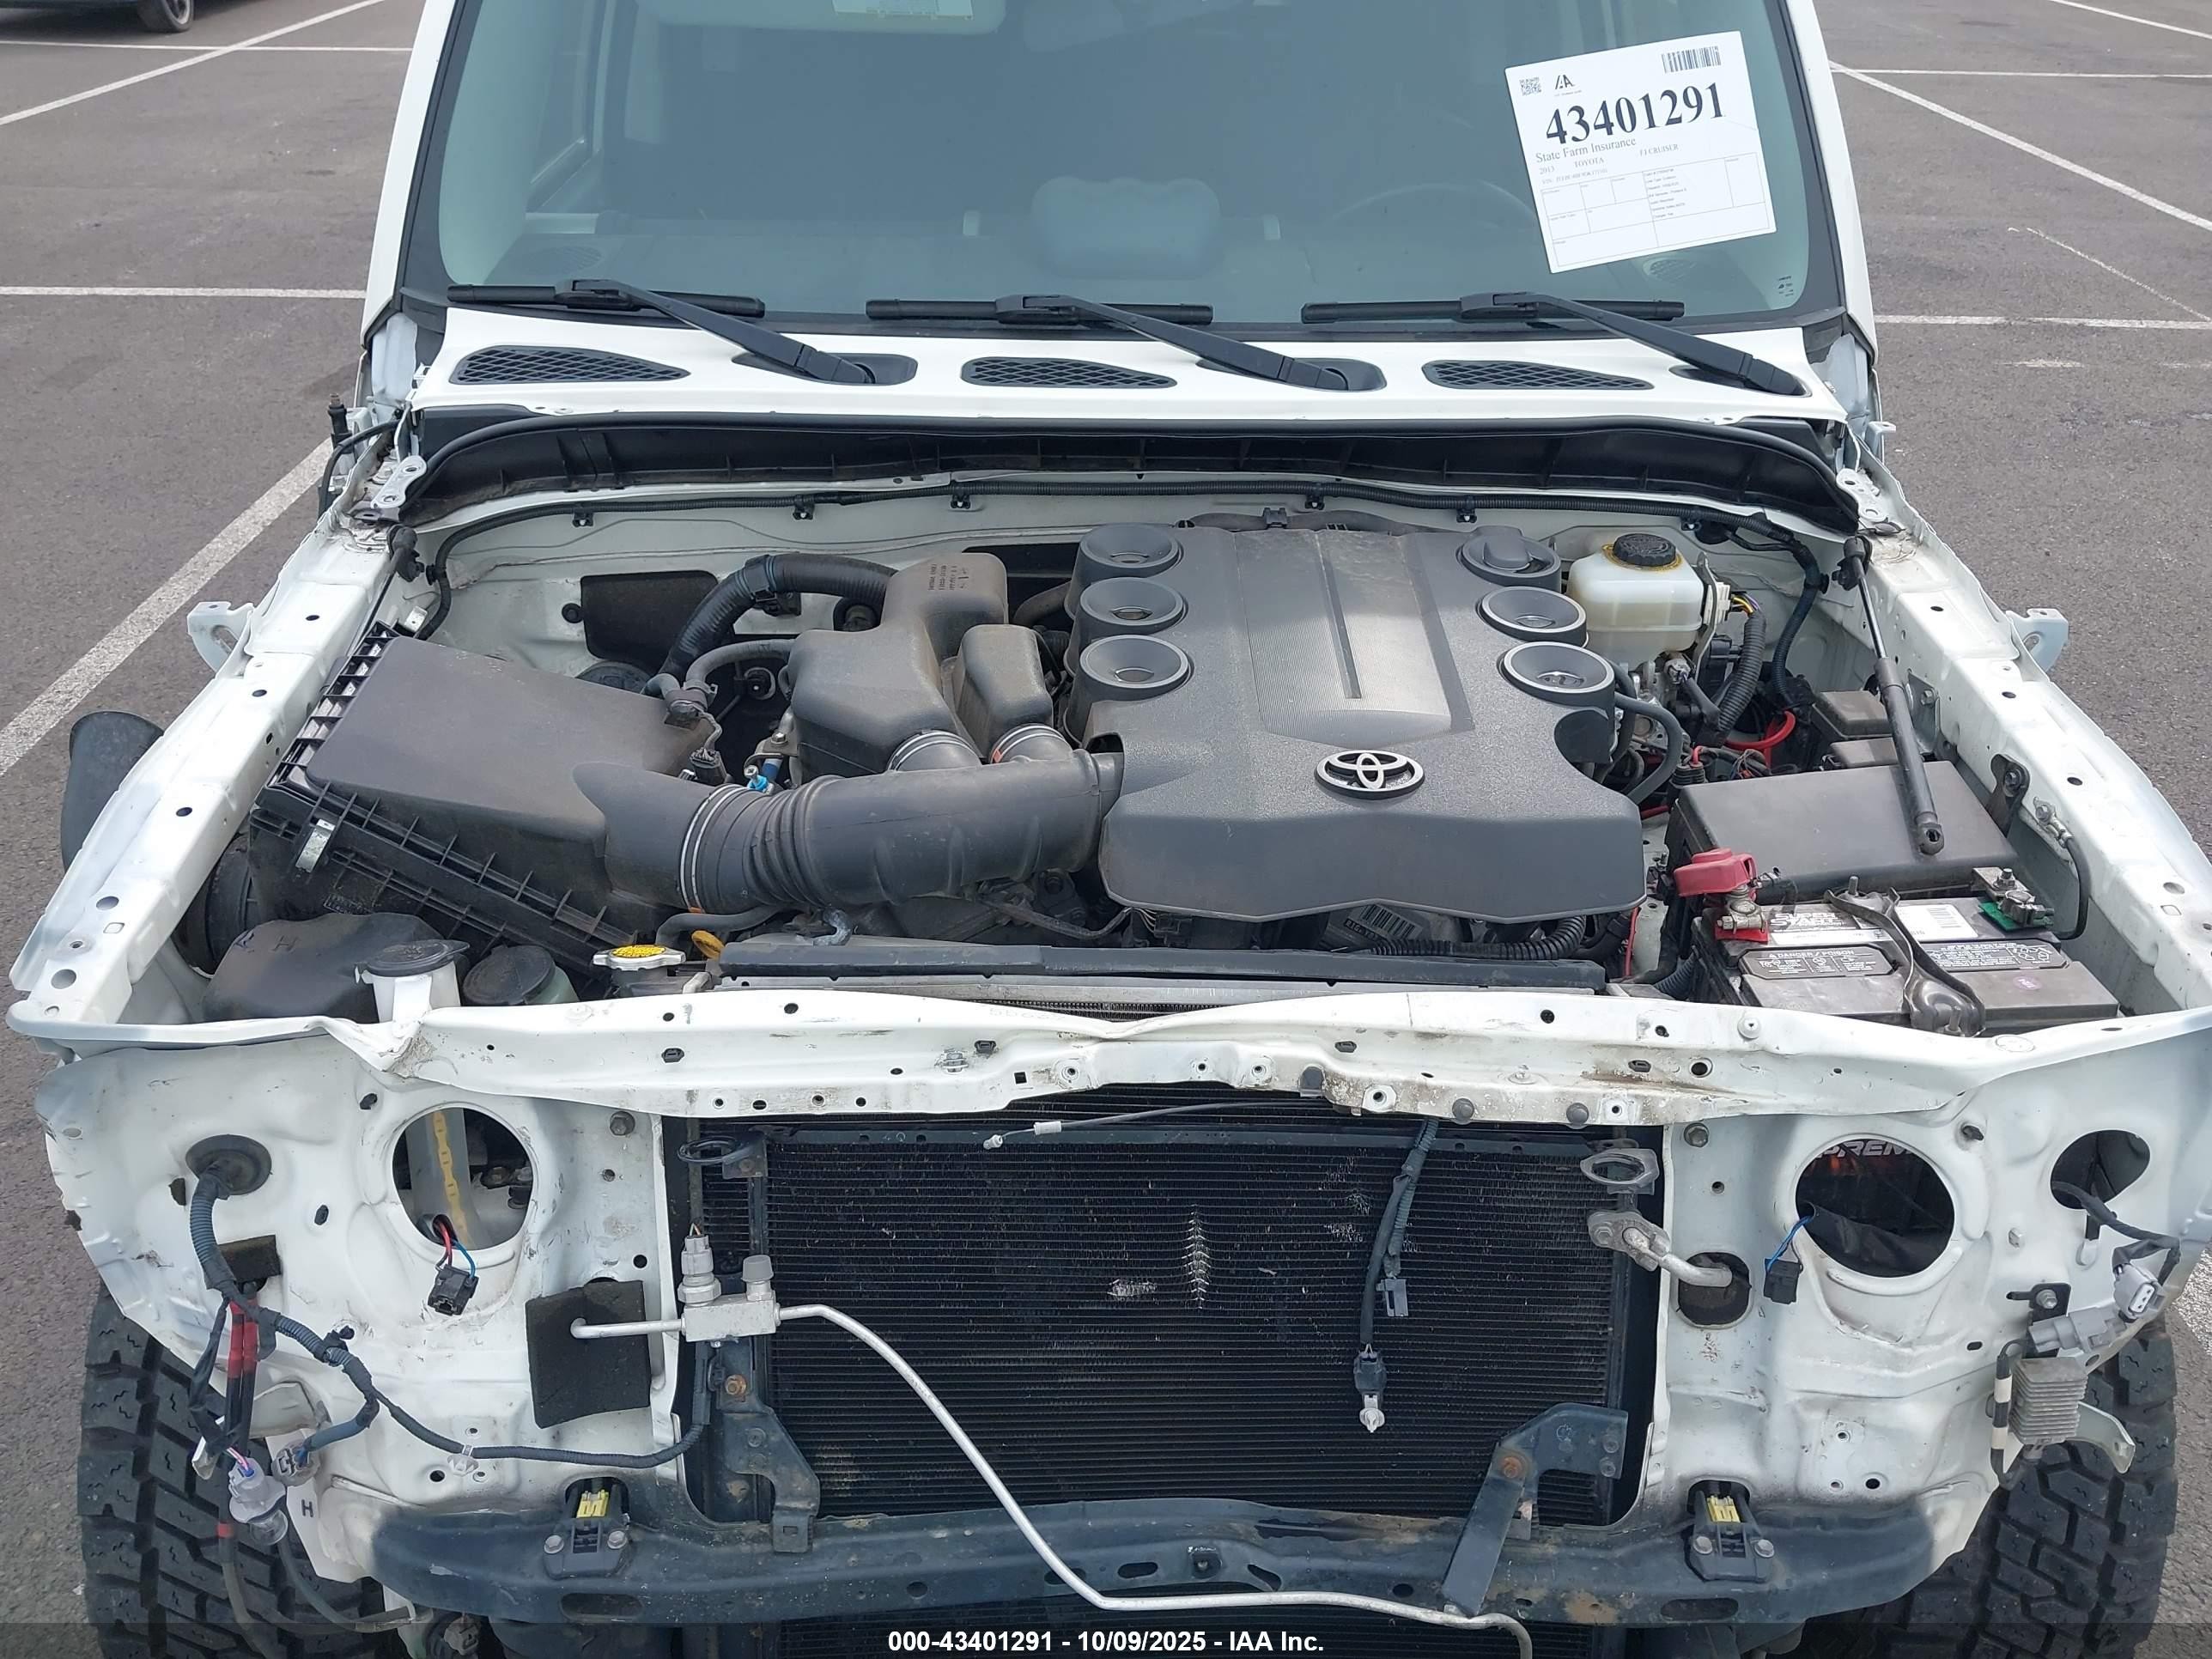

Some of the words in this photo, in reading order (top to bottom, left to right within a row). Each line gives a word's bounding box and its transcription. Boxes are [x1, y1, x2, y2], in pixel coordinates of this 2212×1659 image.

[1546, 82, 1724, 145] 43401291
[1535, 150, 1561, 164] State
[1563, 145, 1589, 159] Farm
[1591, 138, 1637, 153] Insurance
[1574, 156, 1605, 168] TOYOTA
[1648, 143, 1680, 155] CRUISER
[1770, 918, 1833, 927] START
[301, 1499, 313, 1517] H
